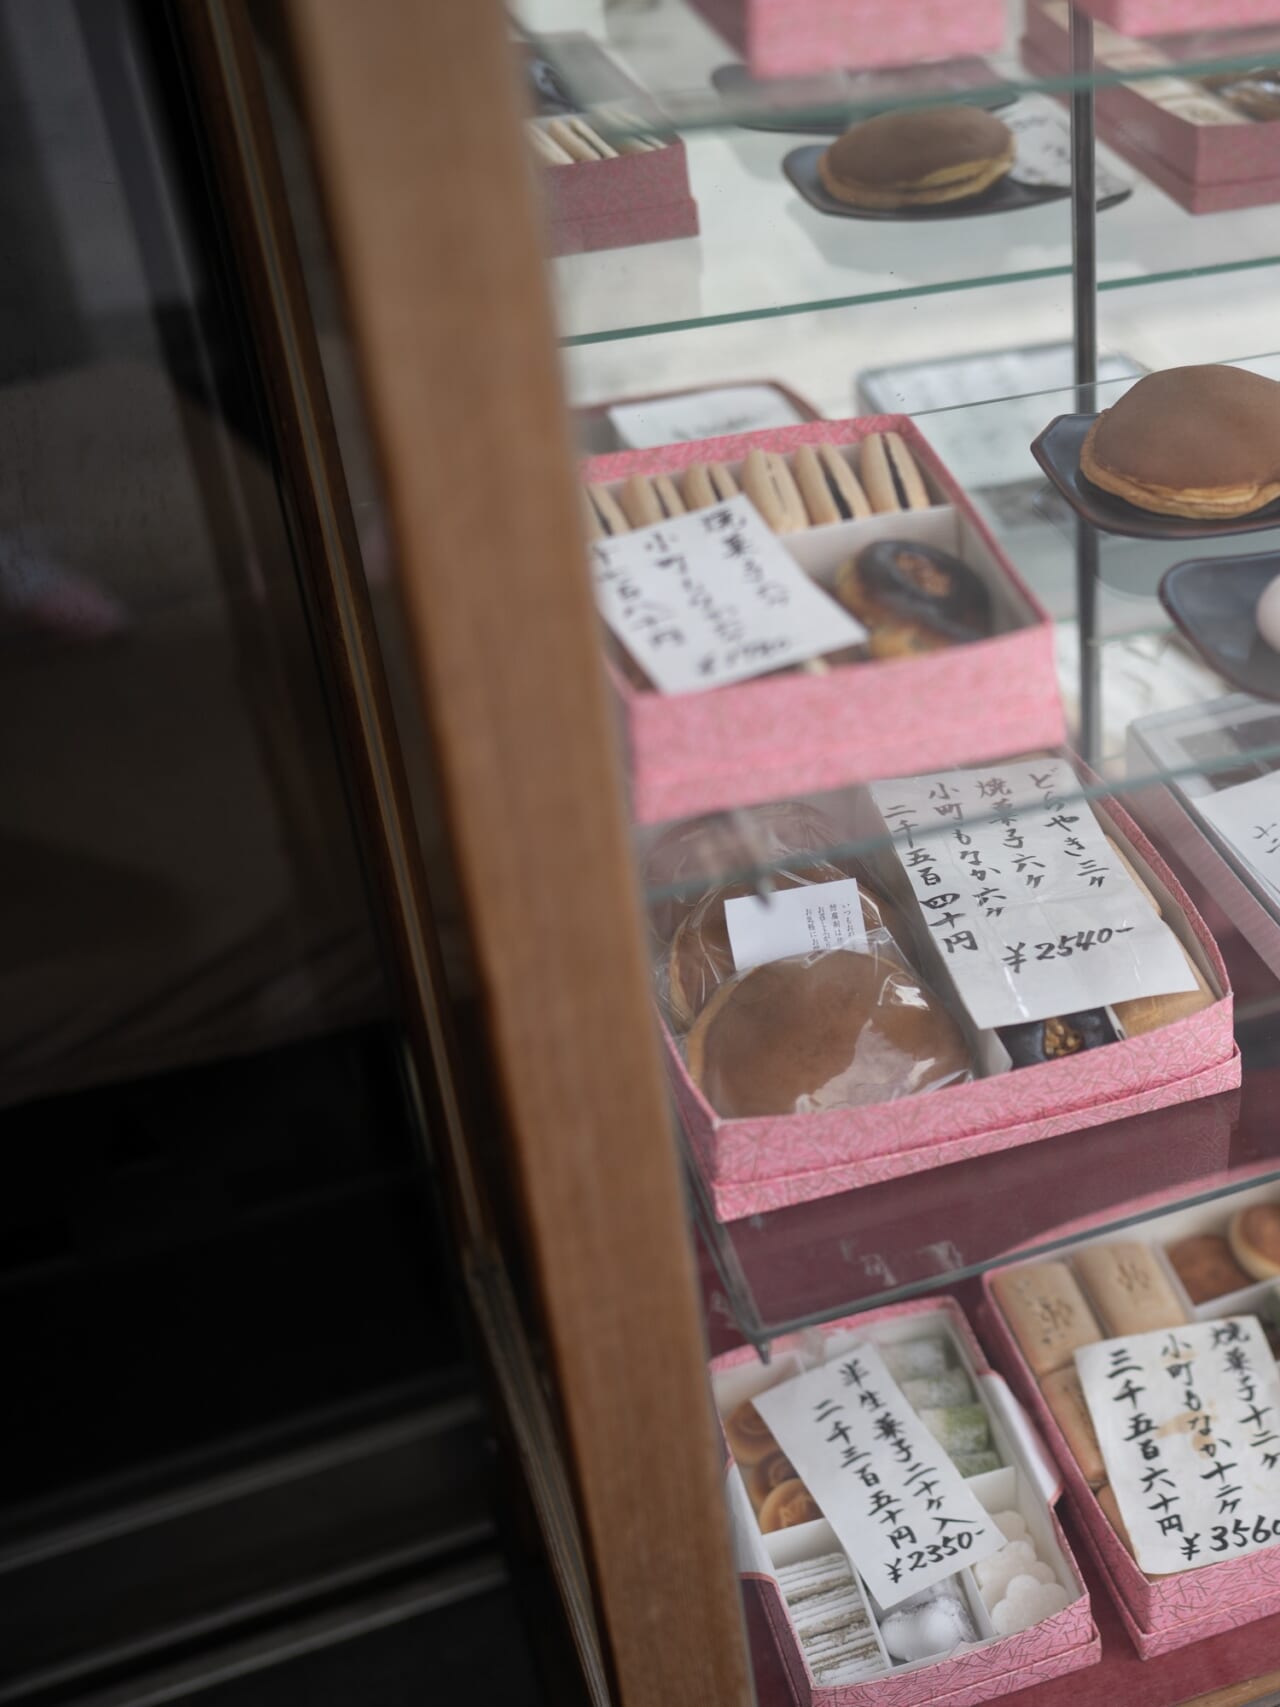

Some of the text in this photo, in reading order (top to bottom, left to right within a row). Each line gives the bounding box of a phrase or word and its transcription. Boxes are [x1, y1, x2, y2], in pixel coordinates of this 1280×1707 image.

[884, 804, 979, 953] 二千五百四十円
[812, 1397, 918, 1550] 二千三百五十円
[1106, 1348, 1186, 1537] 三千五百六十円
